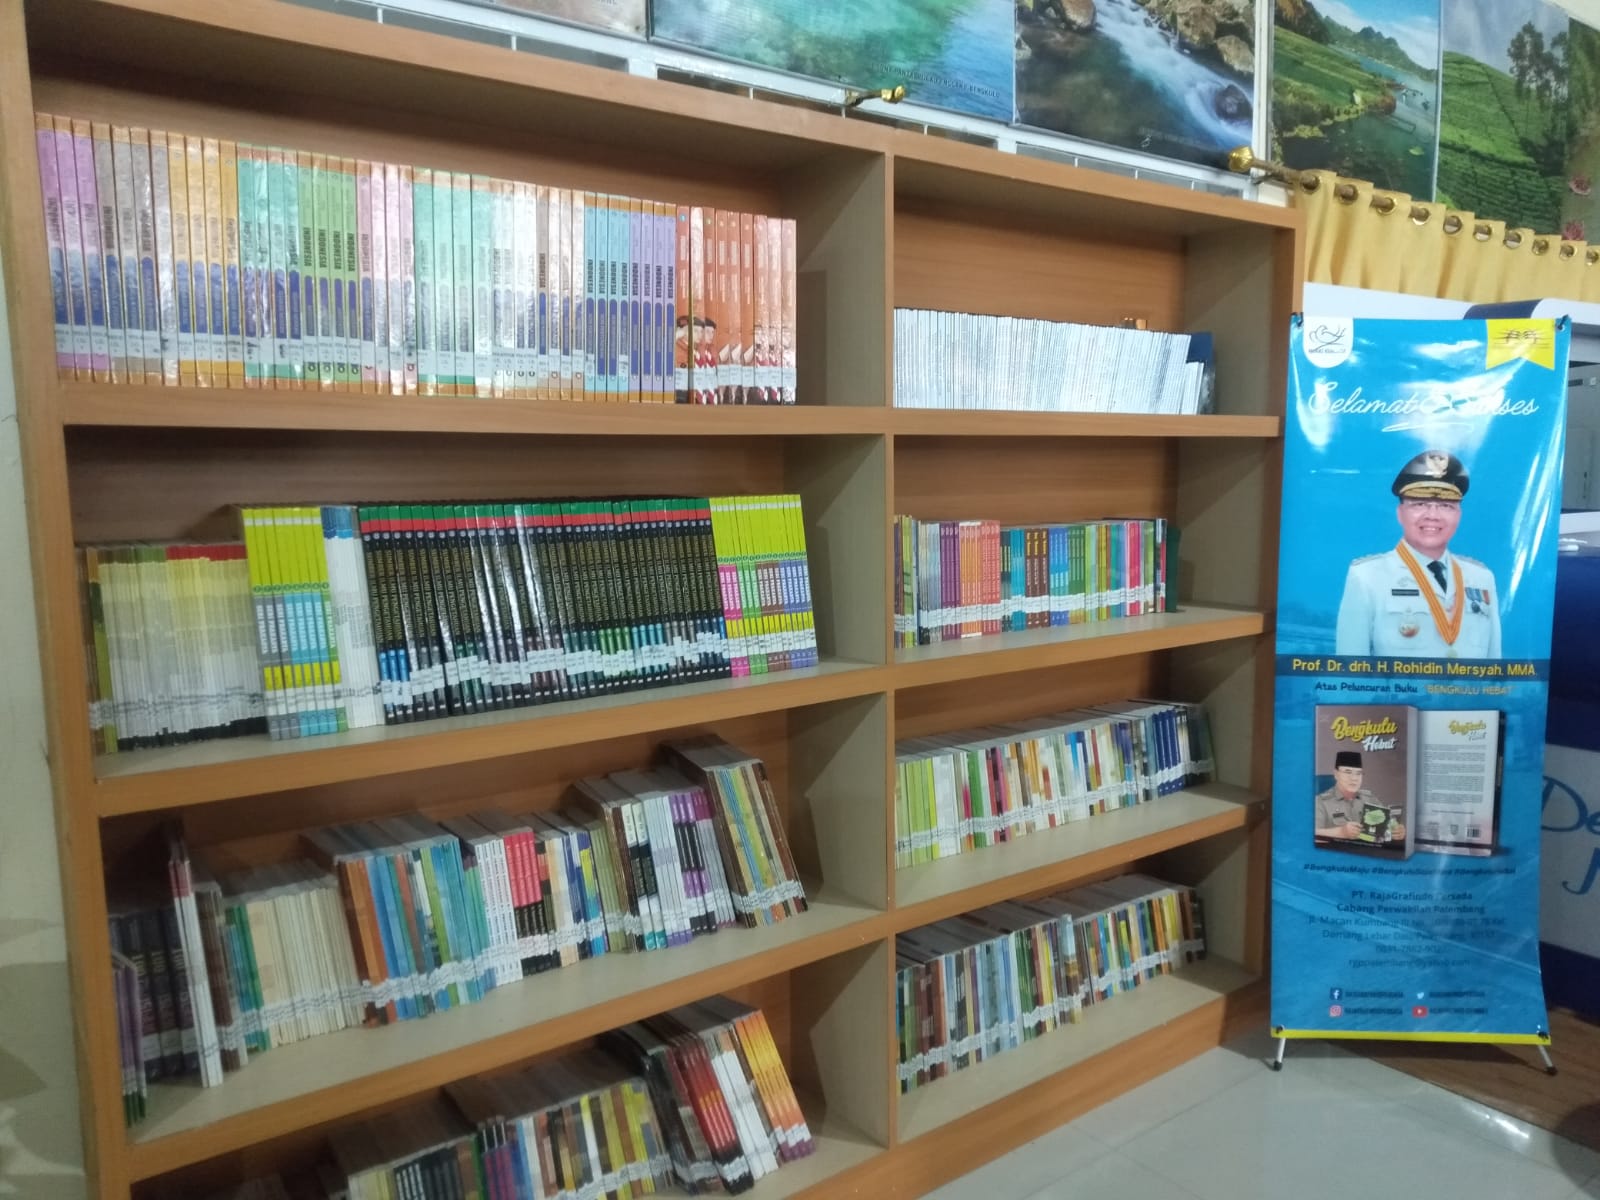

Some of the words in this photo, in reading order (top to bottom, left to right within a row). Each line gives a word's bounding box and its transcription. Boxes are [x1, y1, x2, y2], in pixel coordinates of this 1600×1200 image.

[1292, 659, 1323, 672] Prof.
[1326, 660, 1344, 672] Dr.
[1349, 662, 1373, 673] drh.
[1377, 662, 1390, 673] H.
[1394, 661, 1443, 675] Rohidin
[1315, 682, 1338, 691] Atas
[1340, 682, 1391, 692] Peluncuran
[1395, 683, 1418, 693] Buku
[1331, 716, 1398, 743] Bengkulu
[1362, 735, 1398, 752] Hebat
